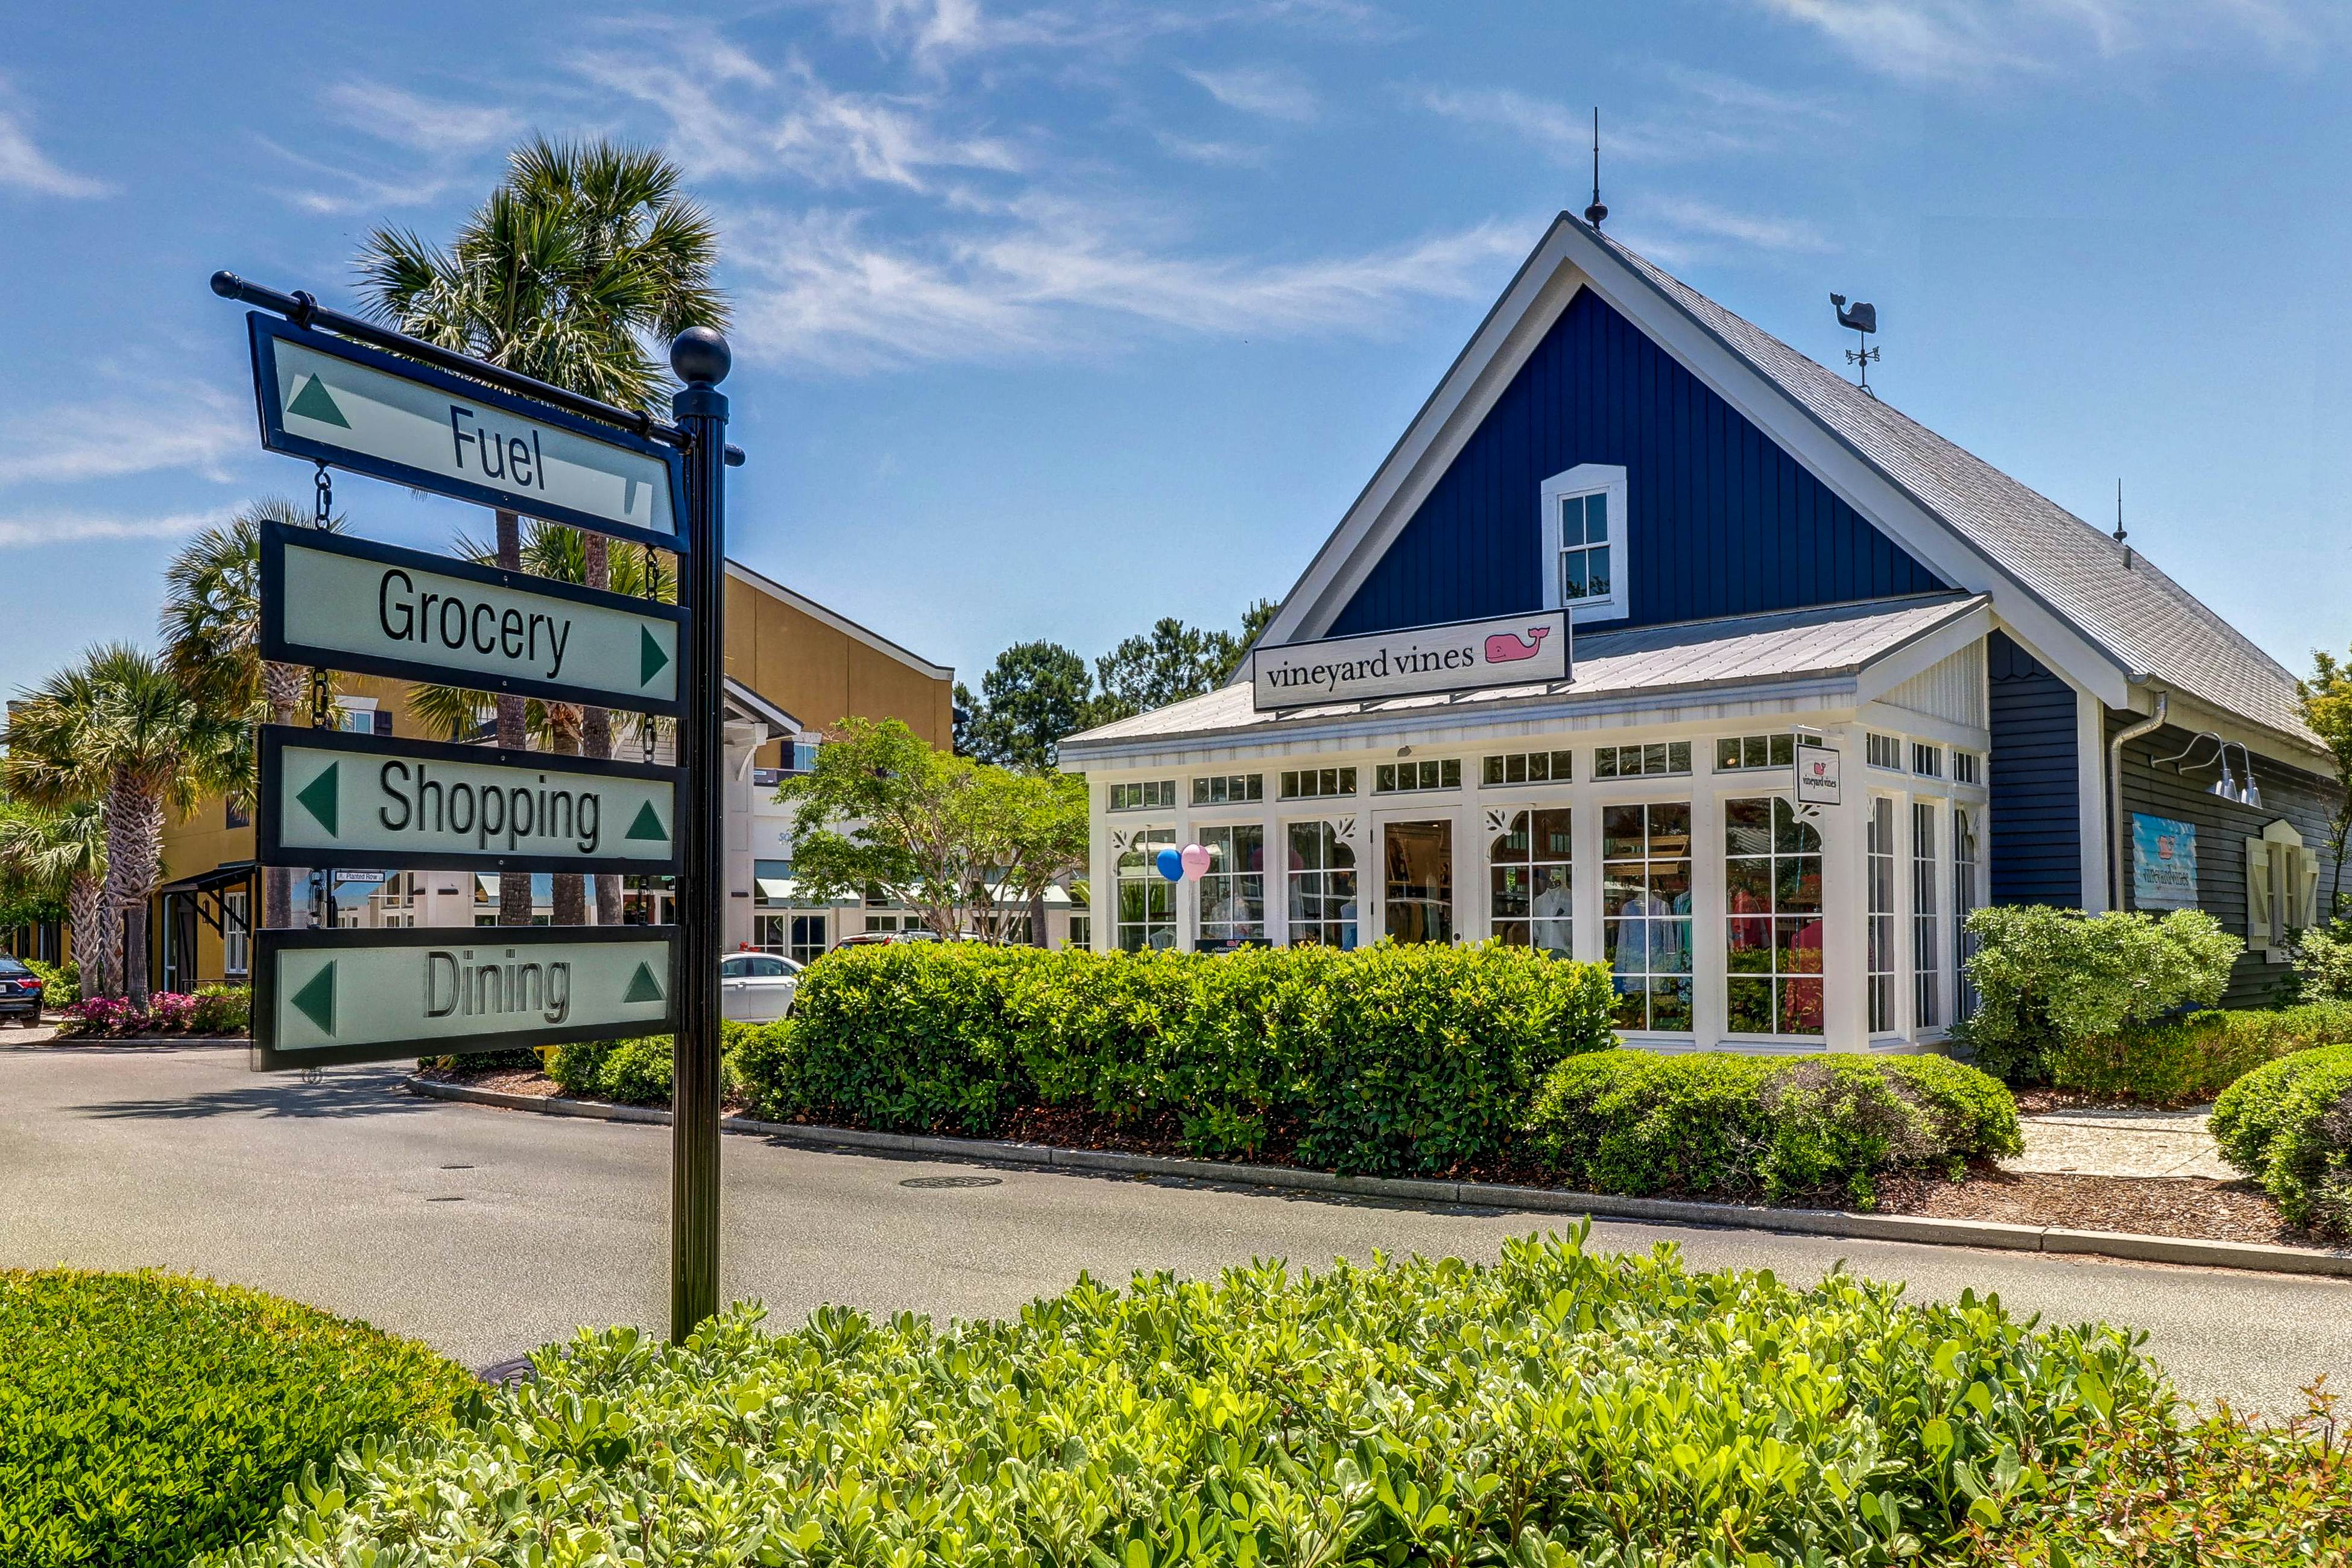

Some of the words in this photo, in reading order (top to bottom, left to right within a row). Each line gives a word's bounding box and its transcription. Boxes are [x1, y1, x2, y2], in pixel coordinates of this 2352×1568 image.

[450, 405, 545, 490] Fuel
[379, 569, 571, 680] Grocery
[1266, 649, 1389, 693] vineyard
[1394, 645, 1475, 673] vines
[379, 760, 601, 854] Shopping
[1803, 774, 1824, 789] vineyard
[1824, 776, 1836, 788] vines
[423, 949, 571, 1024] Dining
